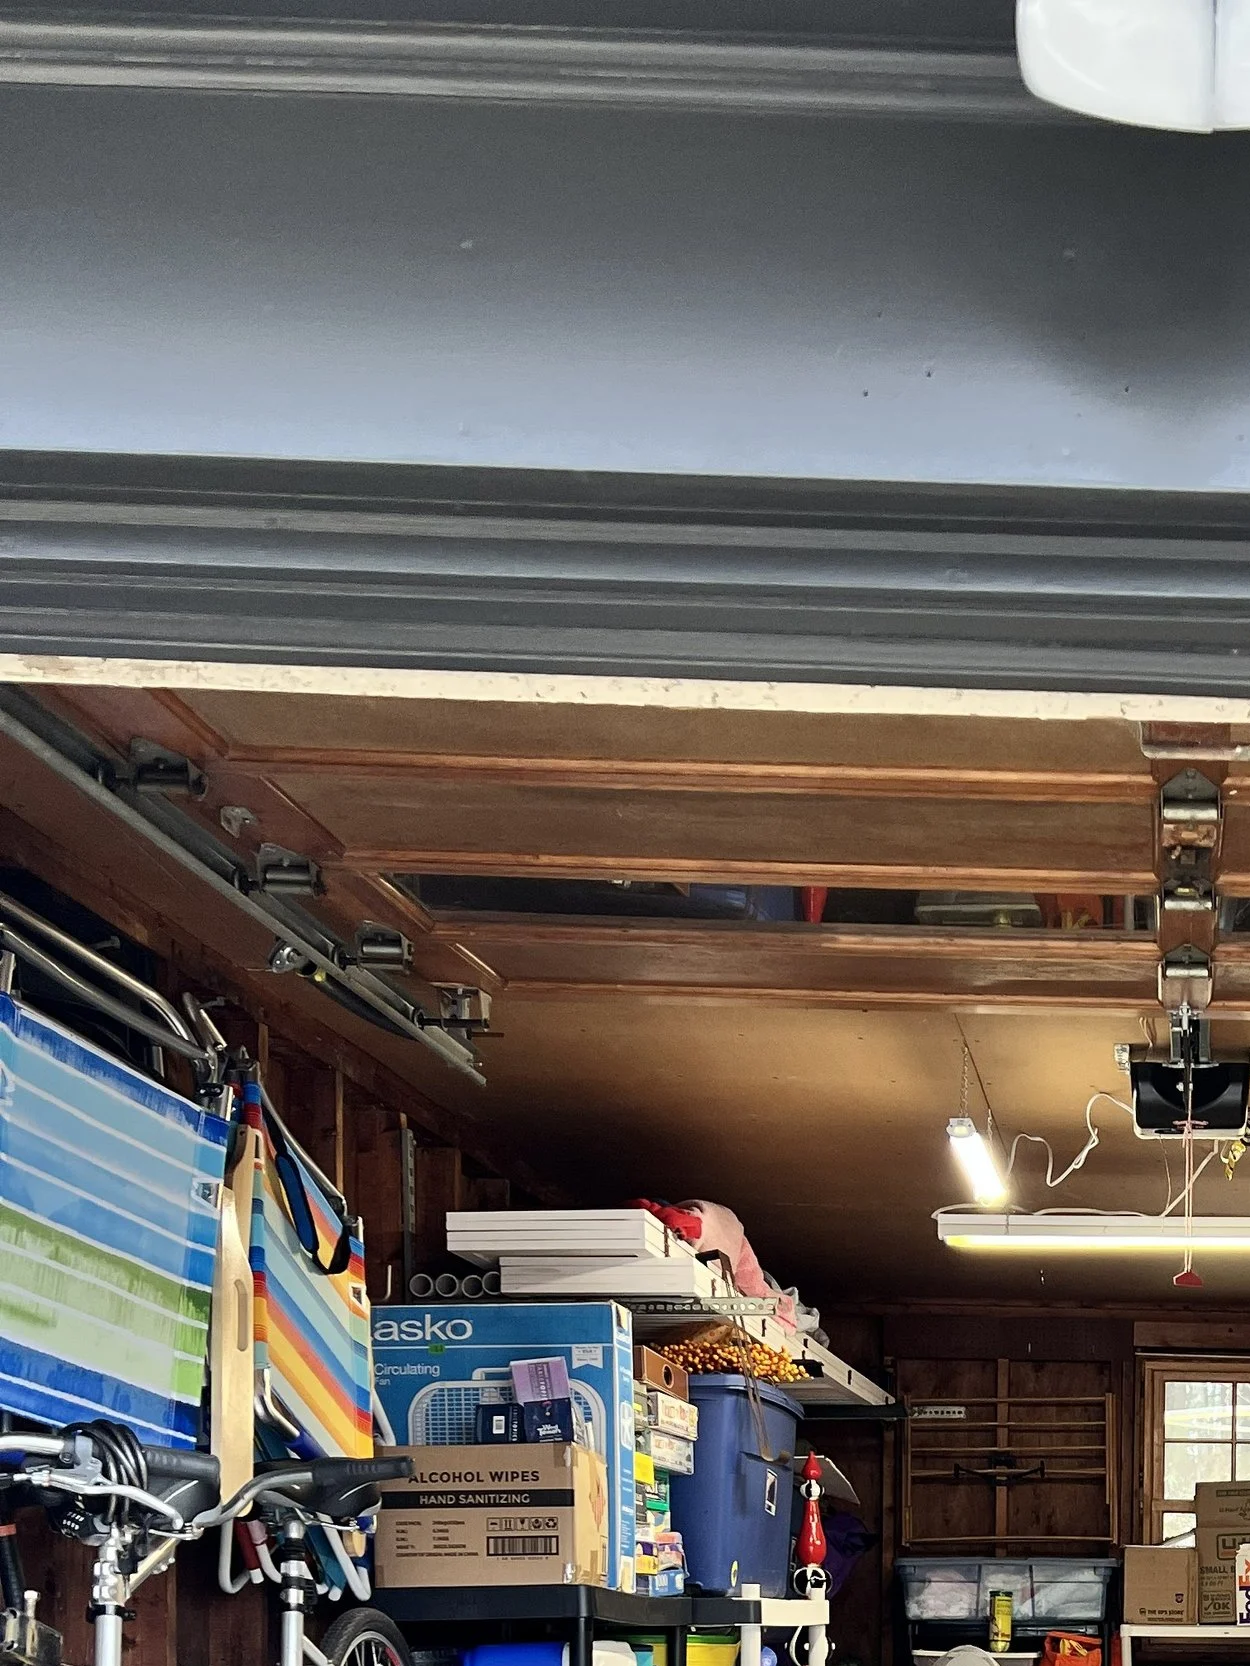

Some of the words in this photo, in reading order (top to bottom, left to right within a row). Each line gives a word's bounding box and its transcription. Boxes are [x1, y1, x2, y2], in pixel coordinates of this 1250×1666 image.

[371, 1313, 473, 1341] asko
[374, 1363, 441, 1377] Circulating
[408, 1470, 484, 1484] ALCOHOL
[489, 1470, 540, 1483] WIPES
[419, 1495, 456, 1505] HAND
[458, 1493, 531, 1505] SANITIZING
